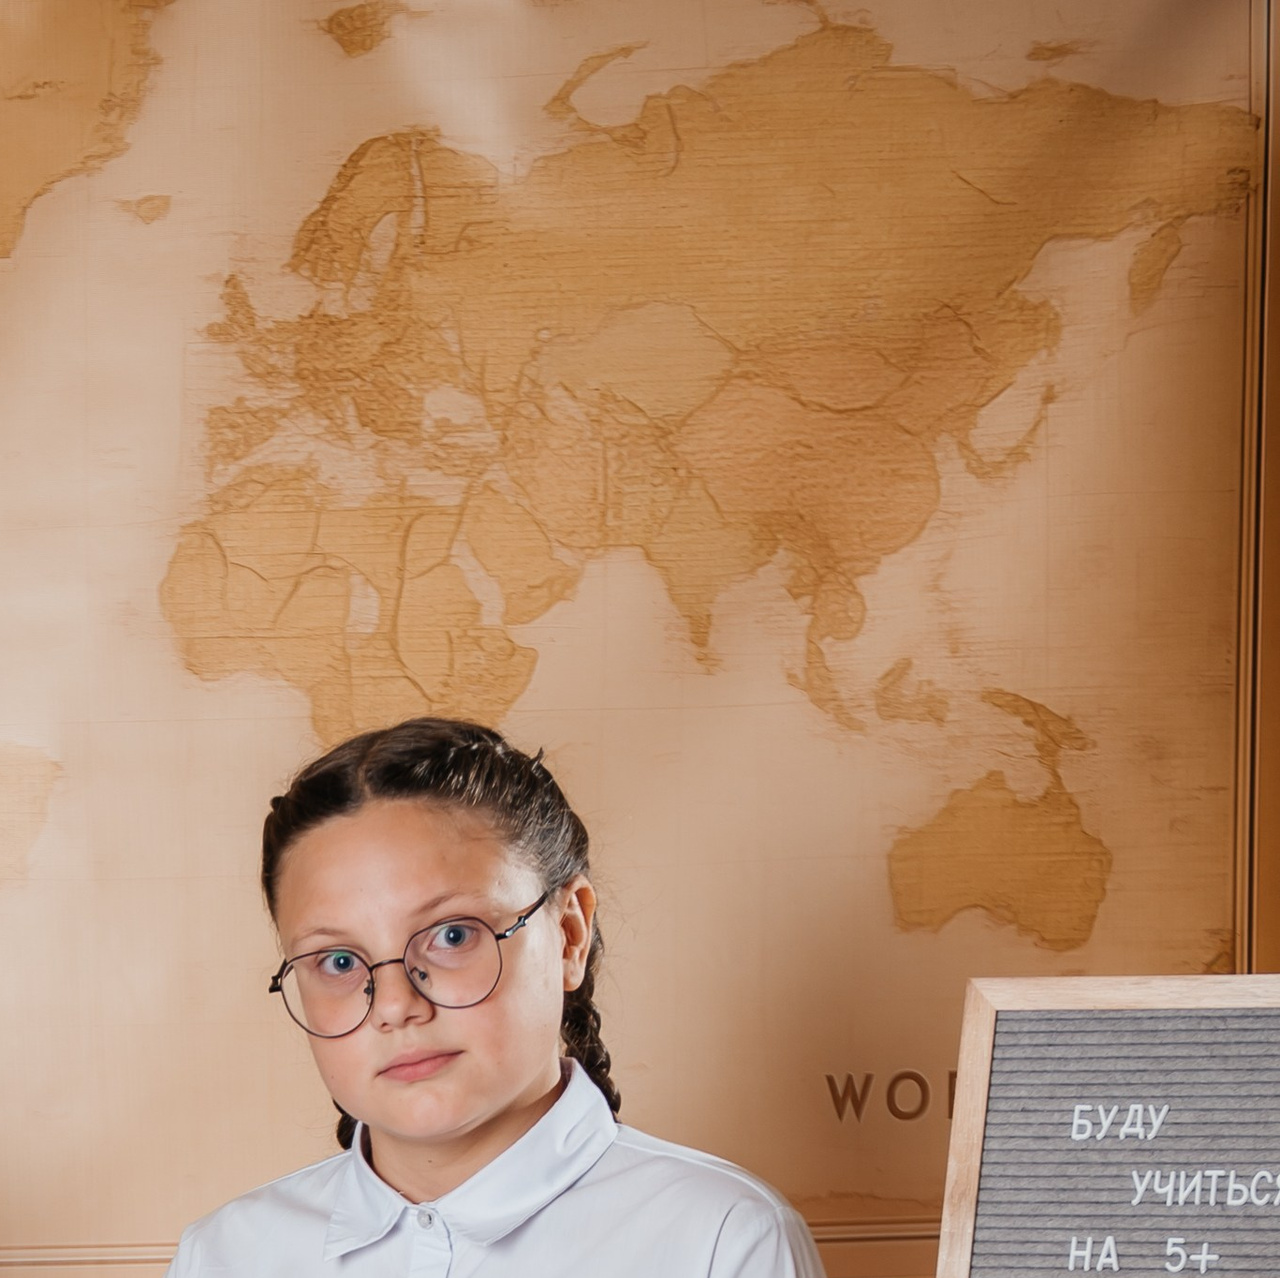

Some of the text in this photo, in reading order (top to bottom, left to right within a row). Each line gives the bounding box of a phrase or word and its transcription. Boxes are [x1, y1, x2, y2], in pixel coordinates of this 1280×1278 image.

[1070, 1103, 1170, 1140] БУДУ
[1067, 1235, 1220, 1274] НА 5+
